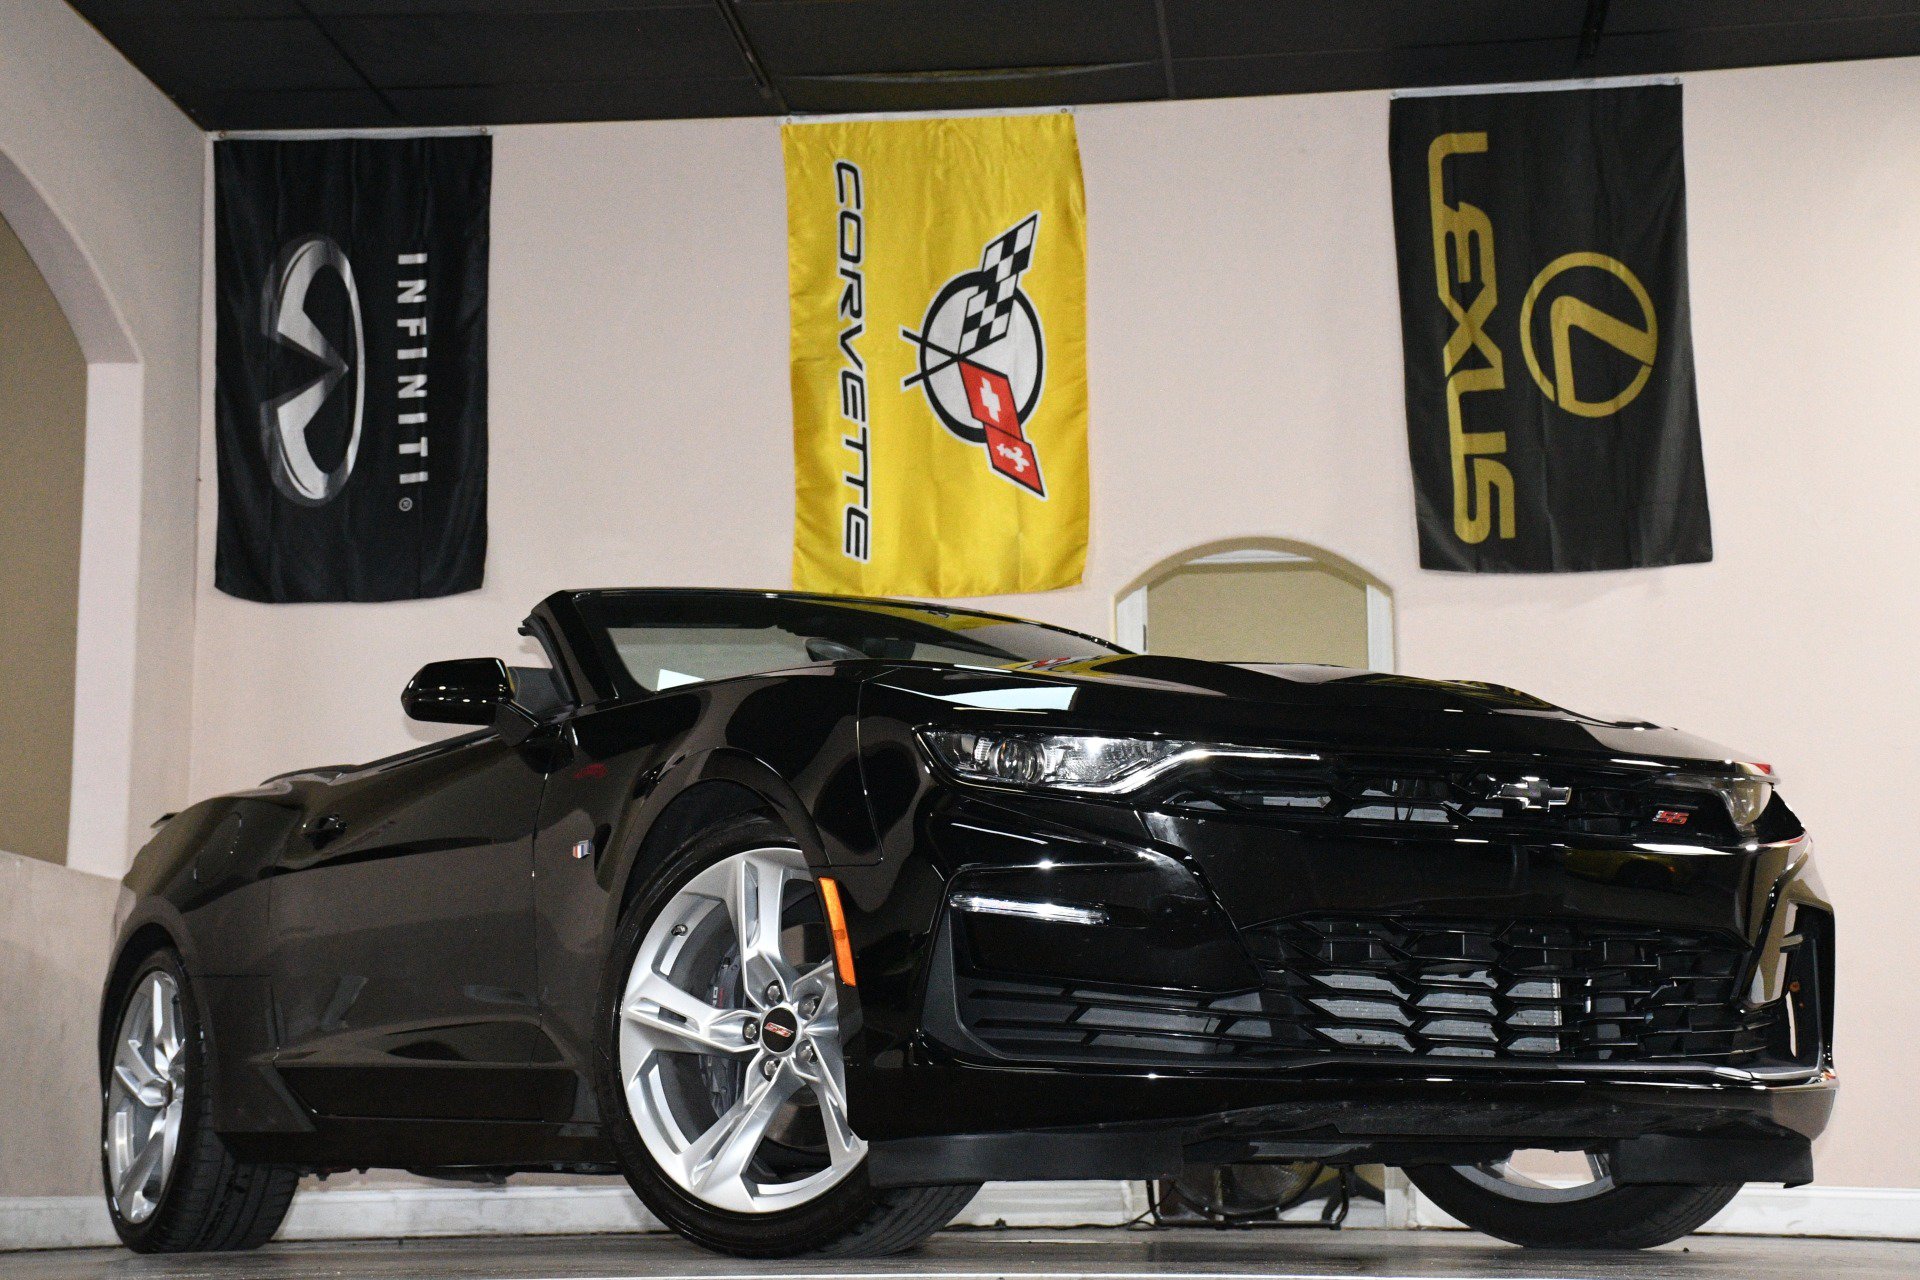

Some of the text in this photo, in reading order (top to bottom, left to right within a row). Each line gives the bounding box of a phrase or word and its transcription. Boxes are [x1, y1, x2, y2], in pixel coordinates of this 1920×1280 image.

[398, 252, 429, 485] INFINITI
[835, 161, 869, 562] CORVETTE
[1428, 132, 1516, 544] LEXUS
